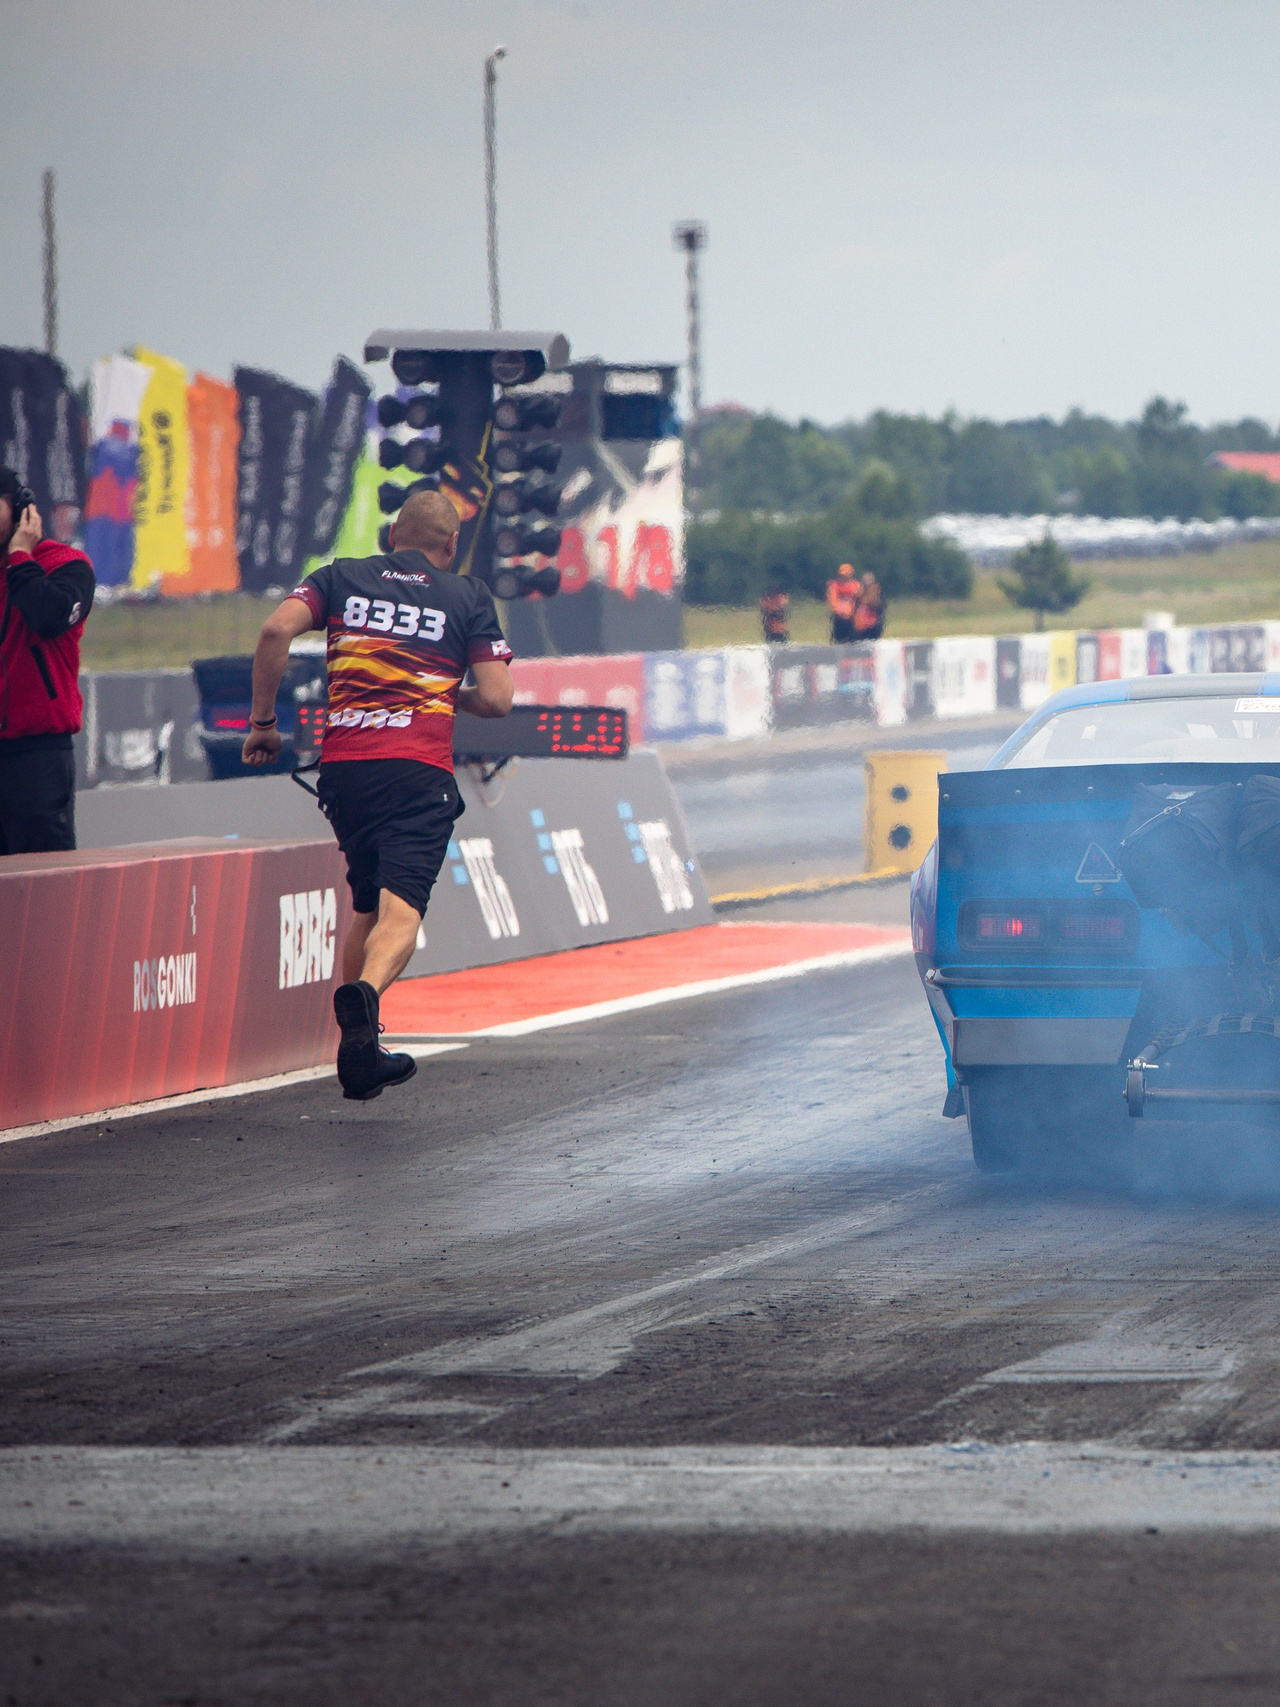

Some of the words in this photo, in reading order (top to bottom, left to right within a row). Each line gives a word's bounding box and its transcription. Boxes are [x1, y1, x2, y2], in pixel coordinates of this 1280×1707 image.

[343, 596, 446, 642] 8333
[279, 888, 337, 990] RDRC
[133, 952, 197, 1012] ROSGONKI
